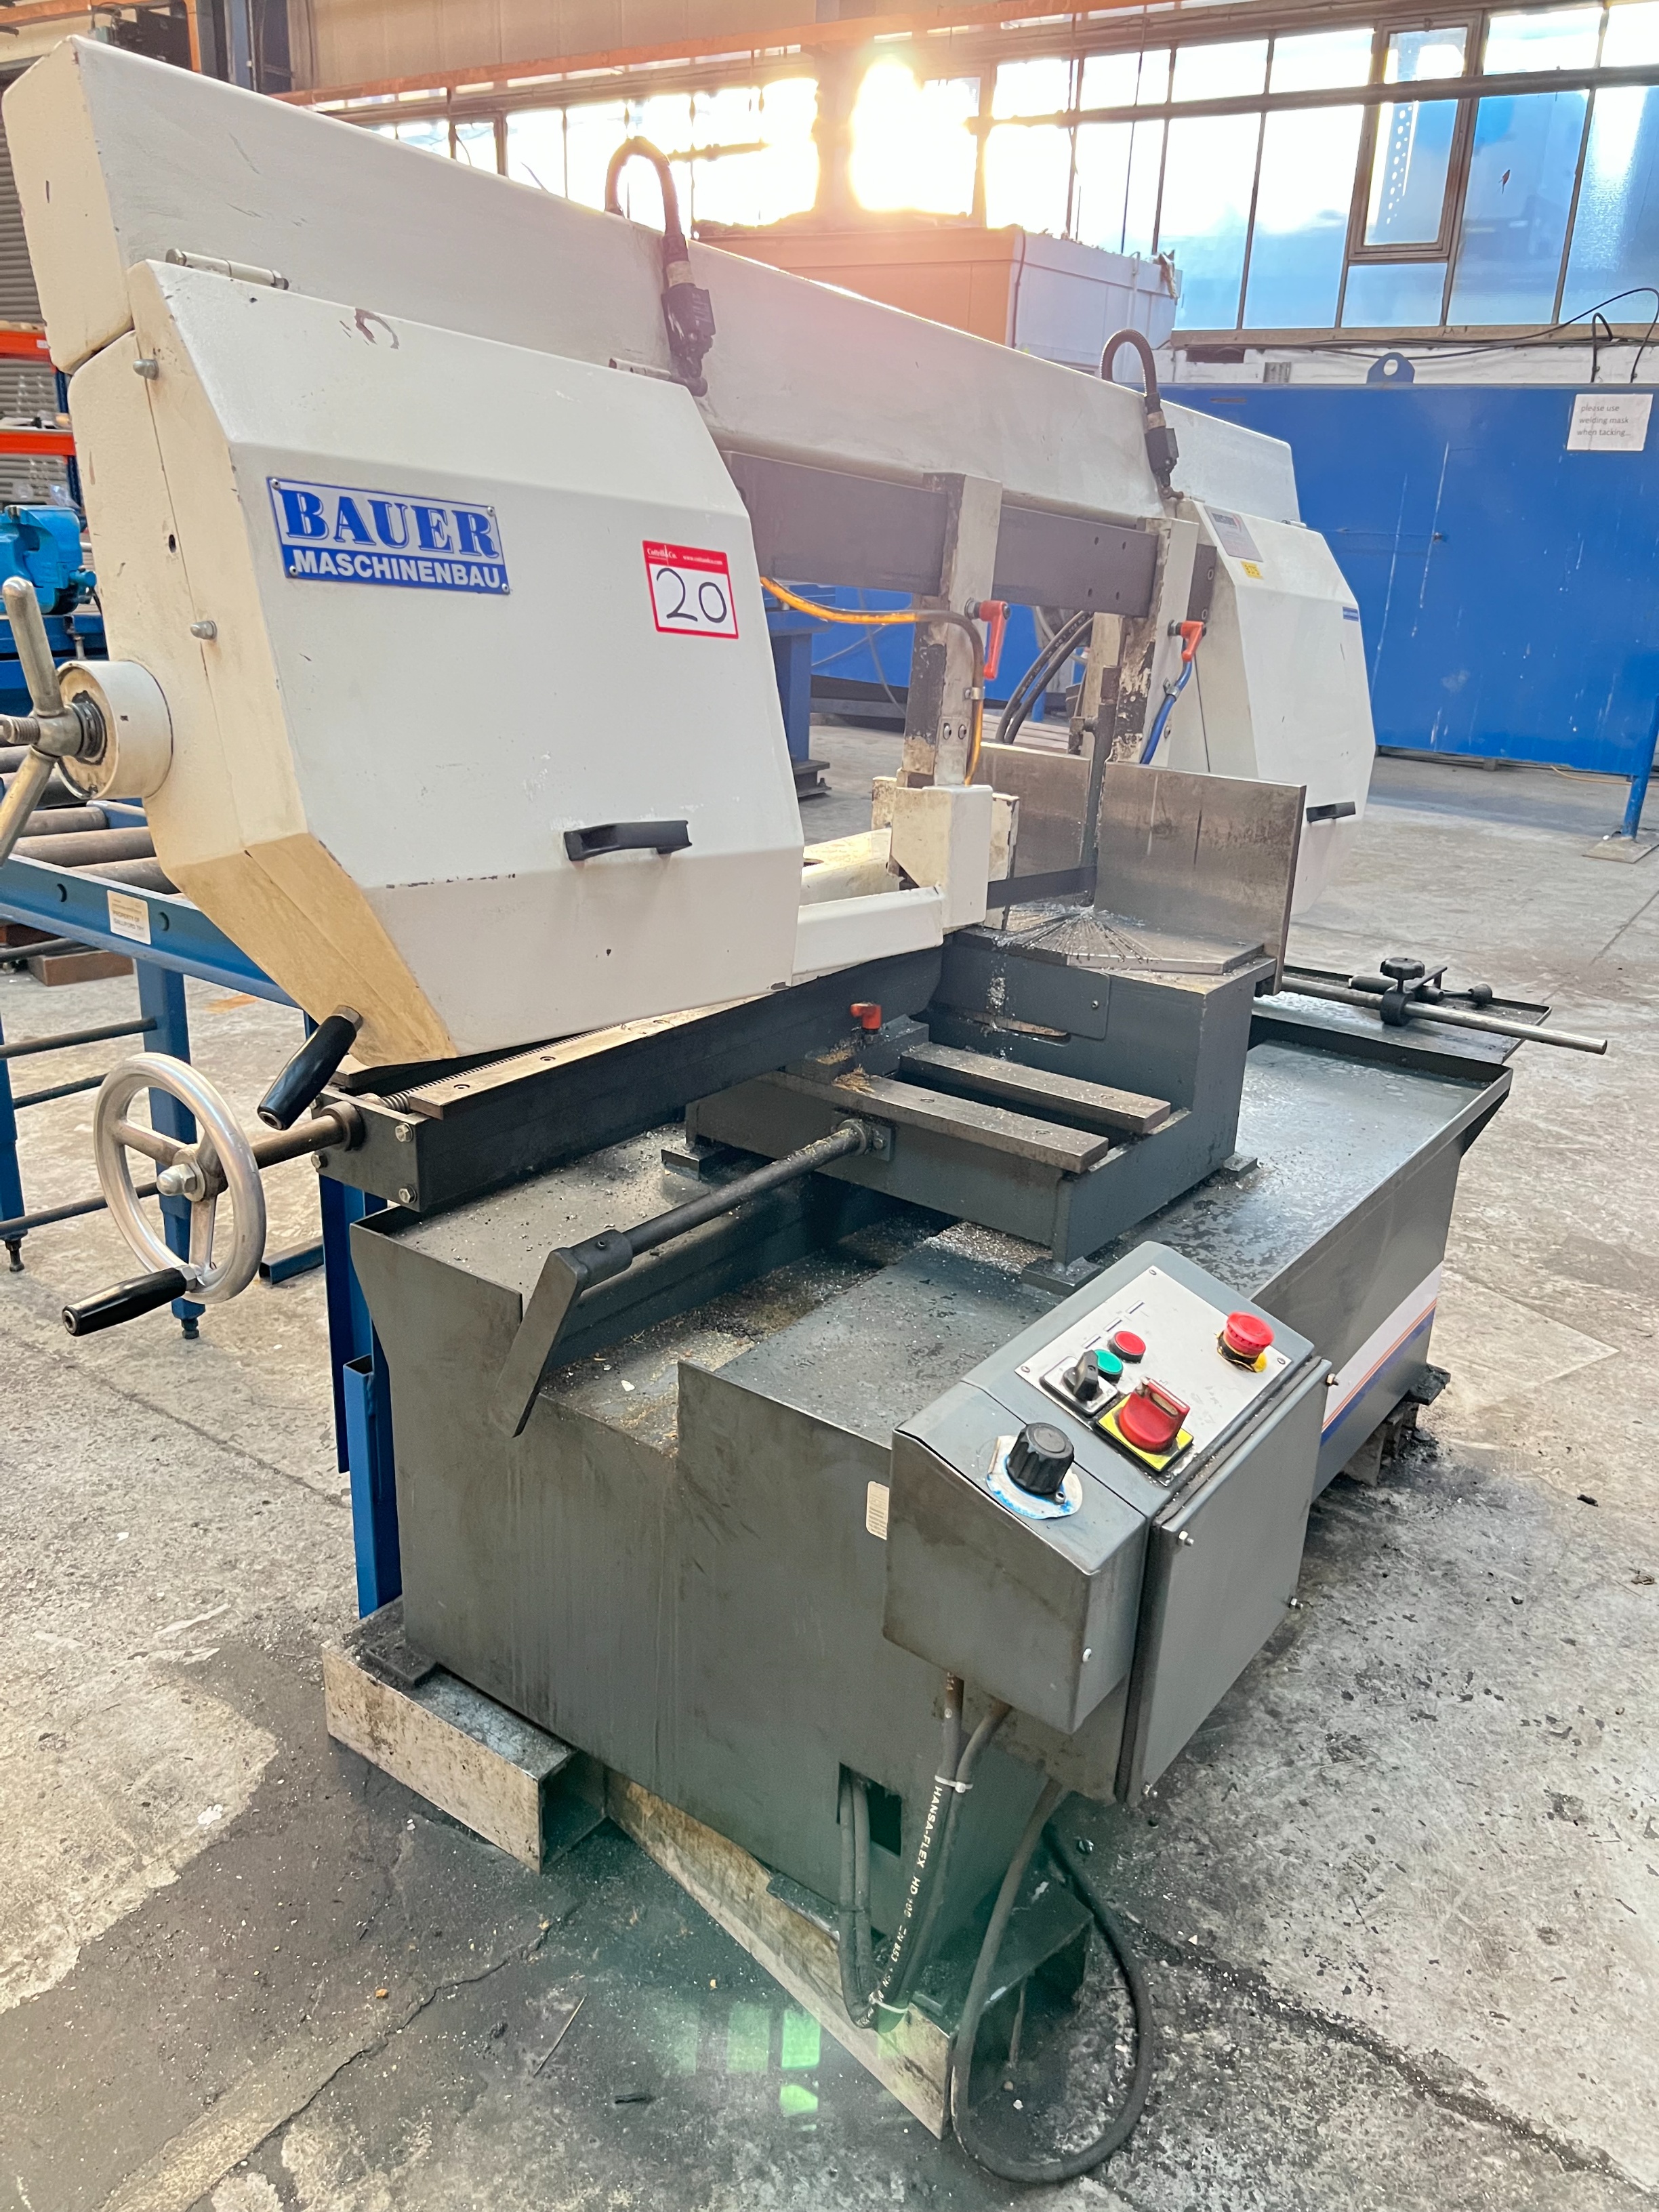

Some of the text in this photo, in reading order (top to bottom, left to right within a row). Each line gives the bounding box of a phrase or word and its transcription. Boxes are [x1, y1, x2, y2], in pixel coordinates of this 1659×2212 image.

[1579, 417, 1608, 426] welding
[1580, 402, 1605, 413] please
[279, 488, 499, 559] BAUER
[292, 549, 501, 588] MASCHINENBAU
[656, 567, 727, 623] 20
[917, 1786, 943, 1868] HANSA-FLEX
[910, 1875, 920, 1895] HD
